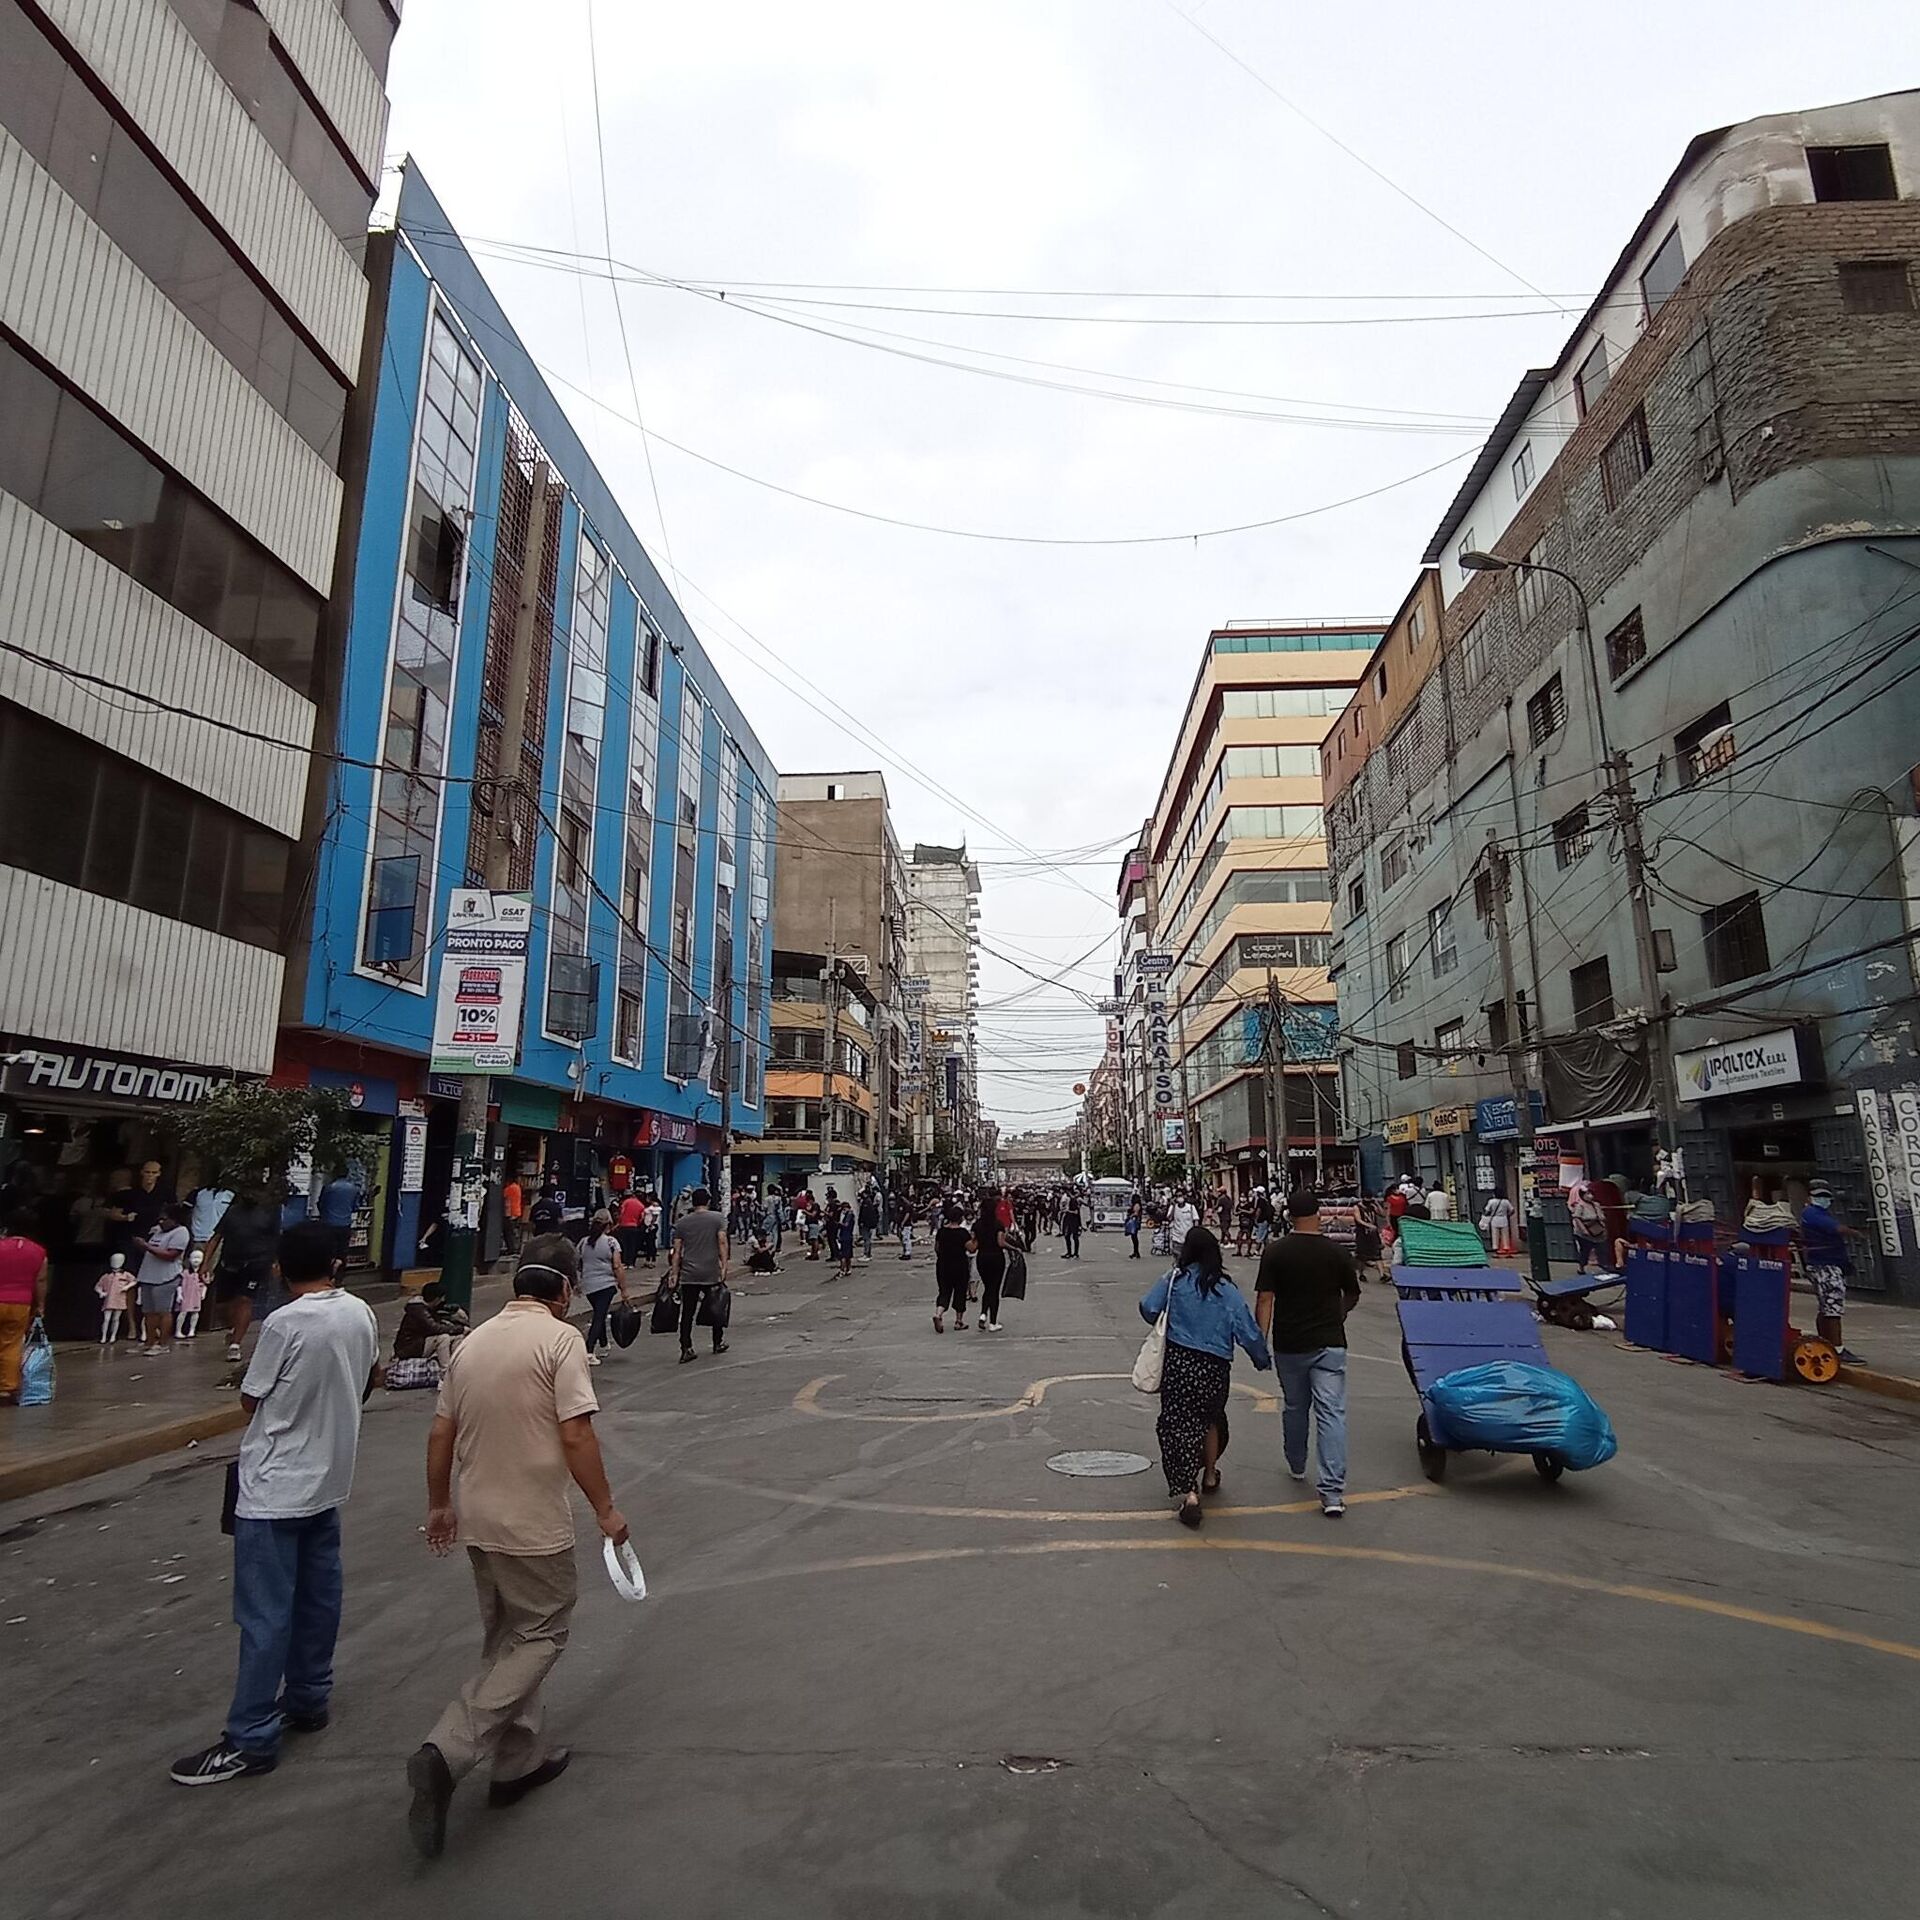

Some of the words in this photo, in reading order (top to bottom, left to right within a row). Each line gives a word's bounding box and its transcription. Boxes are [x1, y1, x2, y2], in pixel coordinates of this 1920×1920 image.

[447, 938, 493, 949] PRONTO
[493, 940, 525, 950] PAGO
[1140, 956, 1169, 966] Centro
[1138, 965, 1173, 973] Comercial
[1147, 982, 1166, 992] EL
[907, 999, 921, 1009] LA
[460, 1008, 496, 1023] 10%
[909, 1020, 921, 1074] REYNA
[1861, 1096, 1897, 1253] PASADORES
